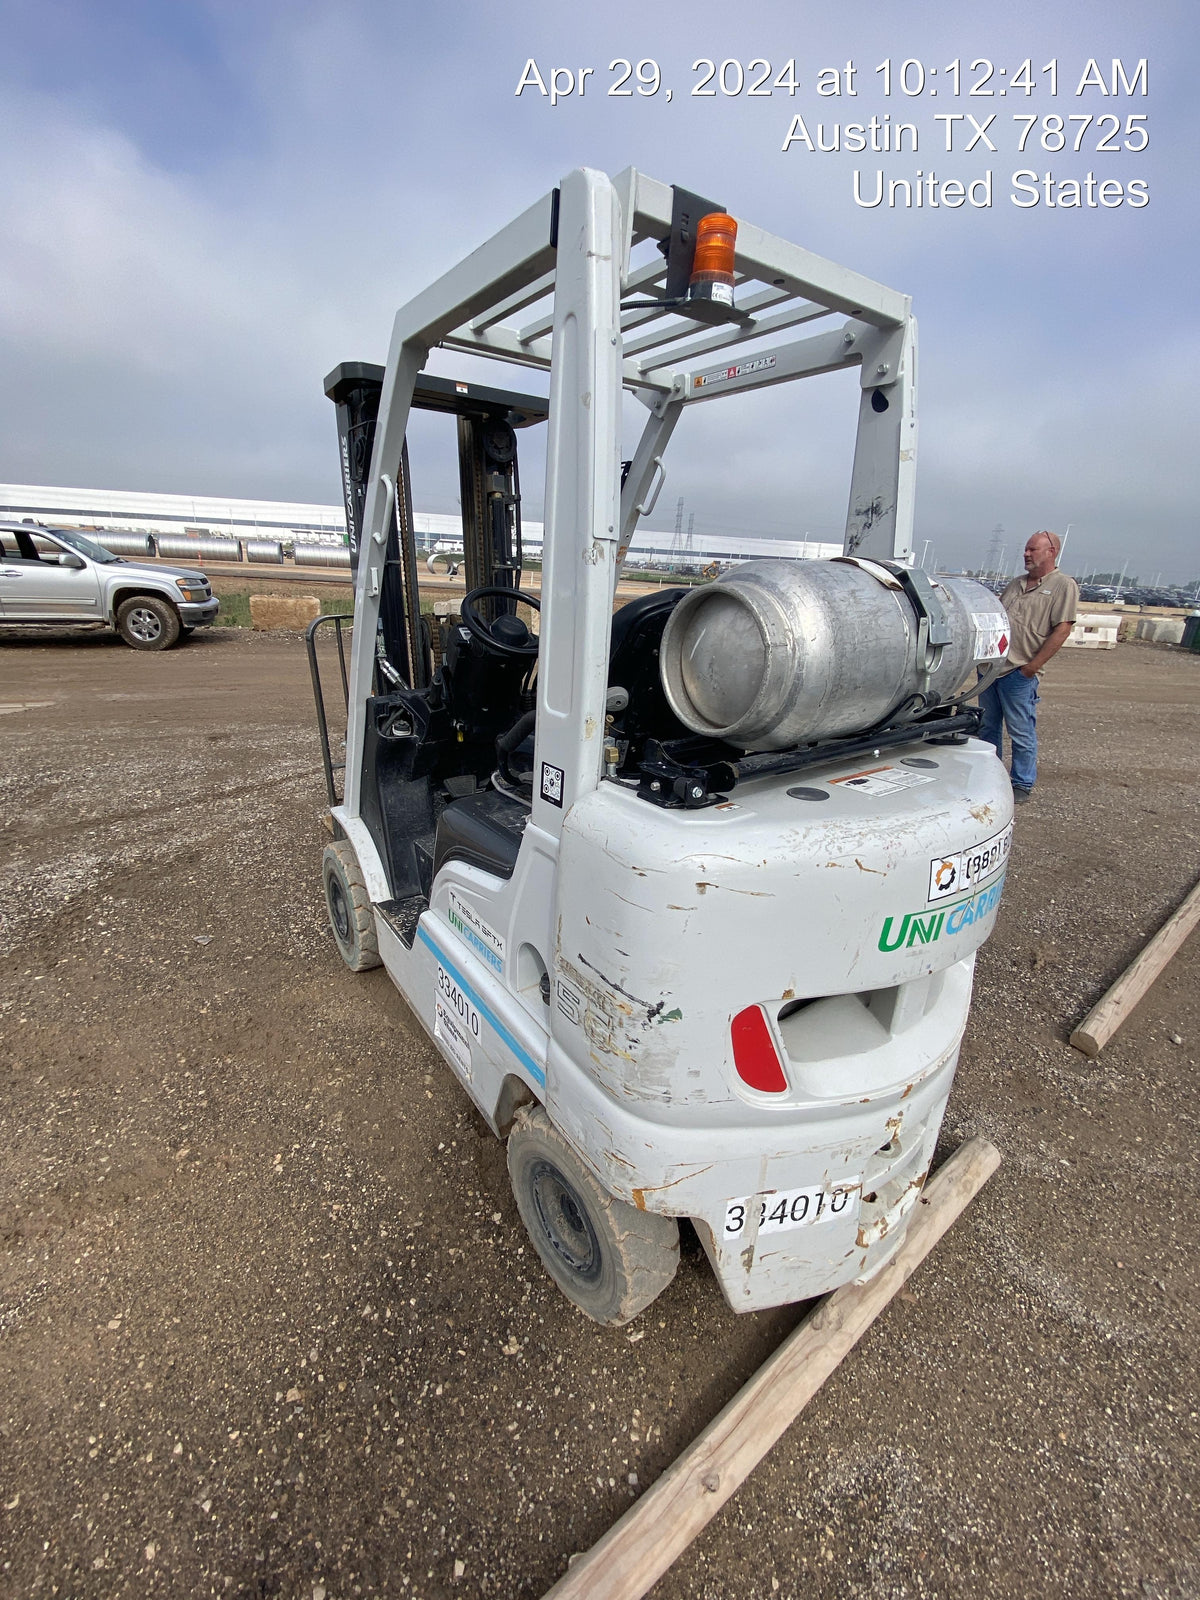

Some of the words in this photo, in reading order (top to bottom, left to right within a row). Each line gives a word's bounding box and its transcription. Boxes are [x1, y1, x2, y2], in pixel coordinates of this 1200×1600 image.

[448, 907, 503, 974] UNICARRIERS
[457, 901, 481, 929] TESLA
[438, 966, 479, 1036] 334010
